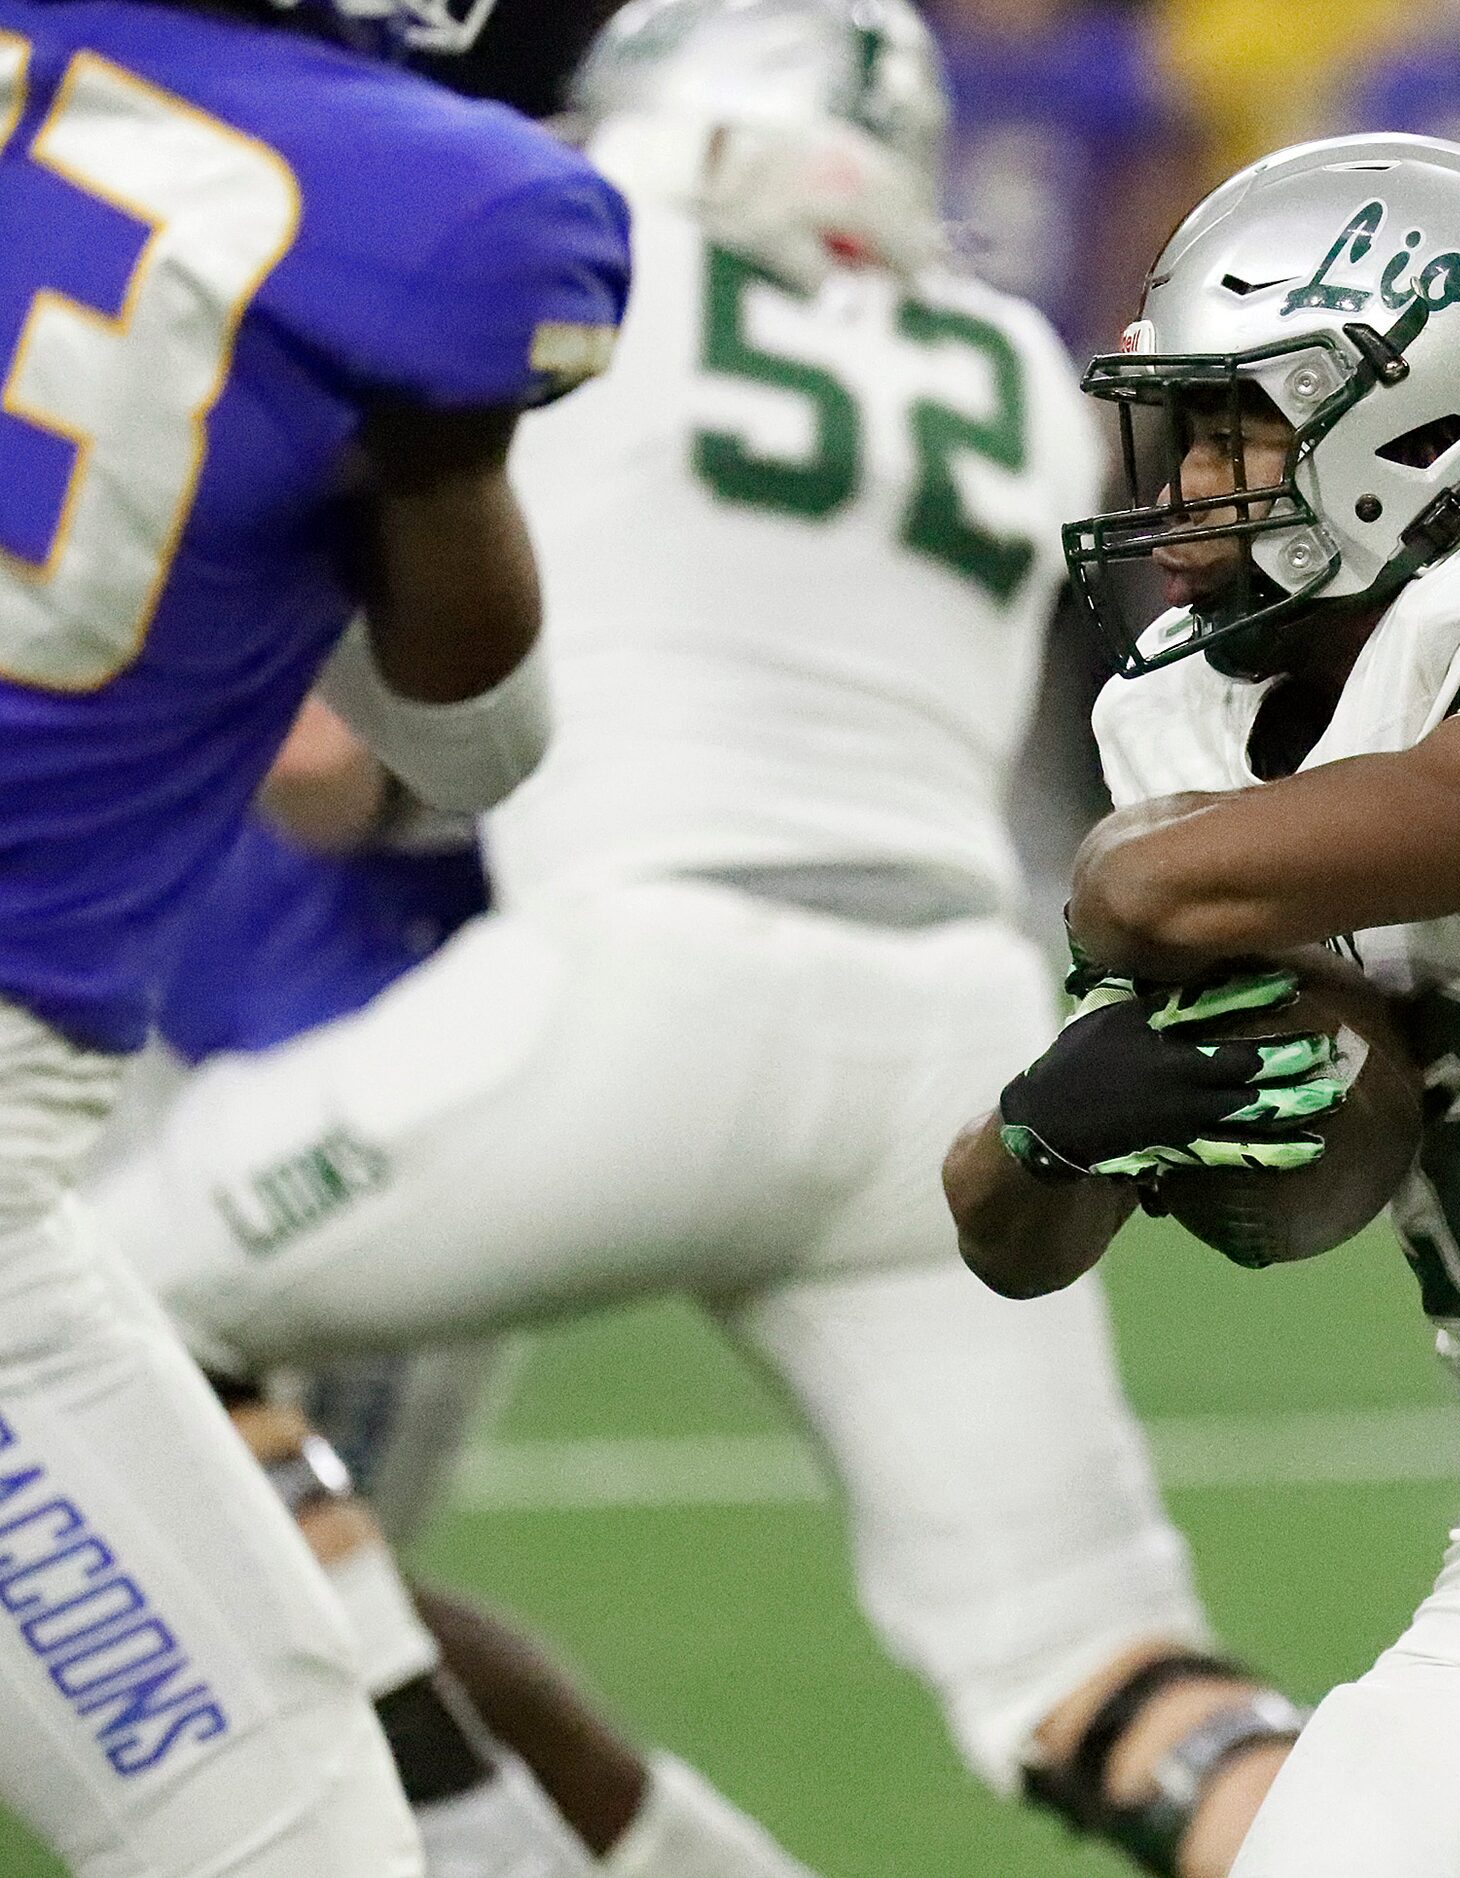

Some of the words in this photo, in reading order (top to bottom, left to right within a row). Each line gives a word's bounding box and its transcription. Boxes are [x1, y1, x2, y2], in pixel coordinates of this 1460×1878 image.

[0, 30, 302, 692] 3
[692, 238, 1036, 610] 52
[0, 1410, 228, 1778] CCOONS
